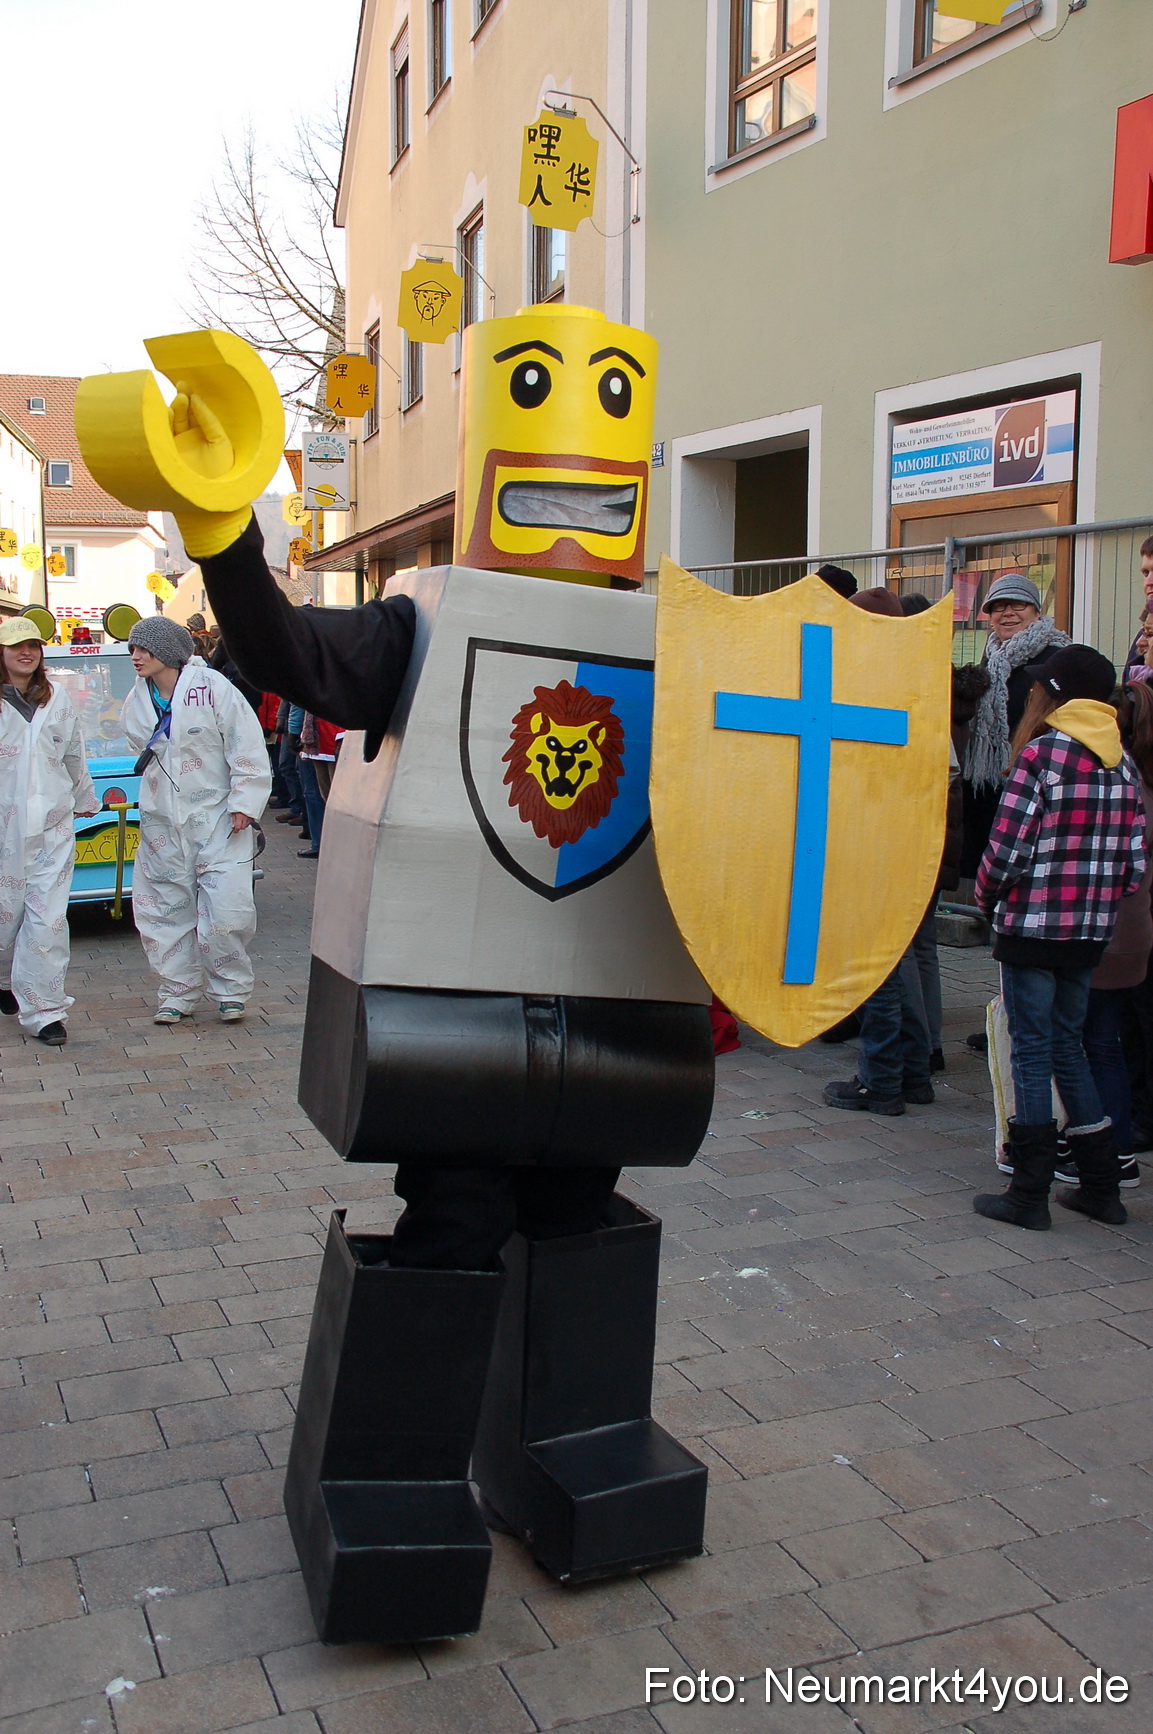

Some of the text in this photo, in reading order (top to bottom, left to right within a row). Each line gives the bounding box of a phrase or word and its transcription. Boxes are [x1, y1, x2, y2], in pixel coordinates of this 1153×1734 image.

[893, 425, 992, 449] VERKAUF VERMIETUNG VERWALTUNG
[923, 425, 933, 433] und
[999, 425, 1040, 463] ivd
[893, 446, 990, 474] IMMOBILIENBÜRO
[69, 646, 101, 655] SPORT
